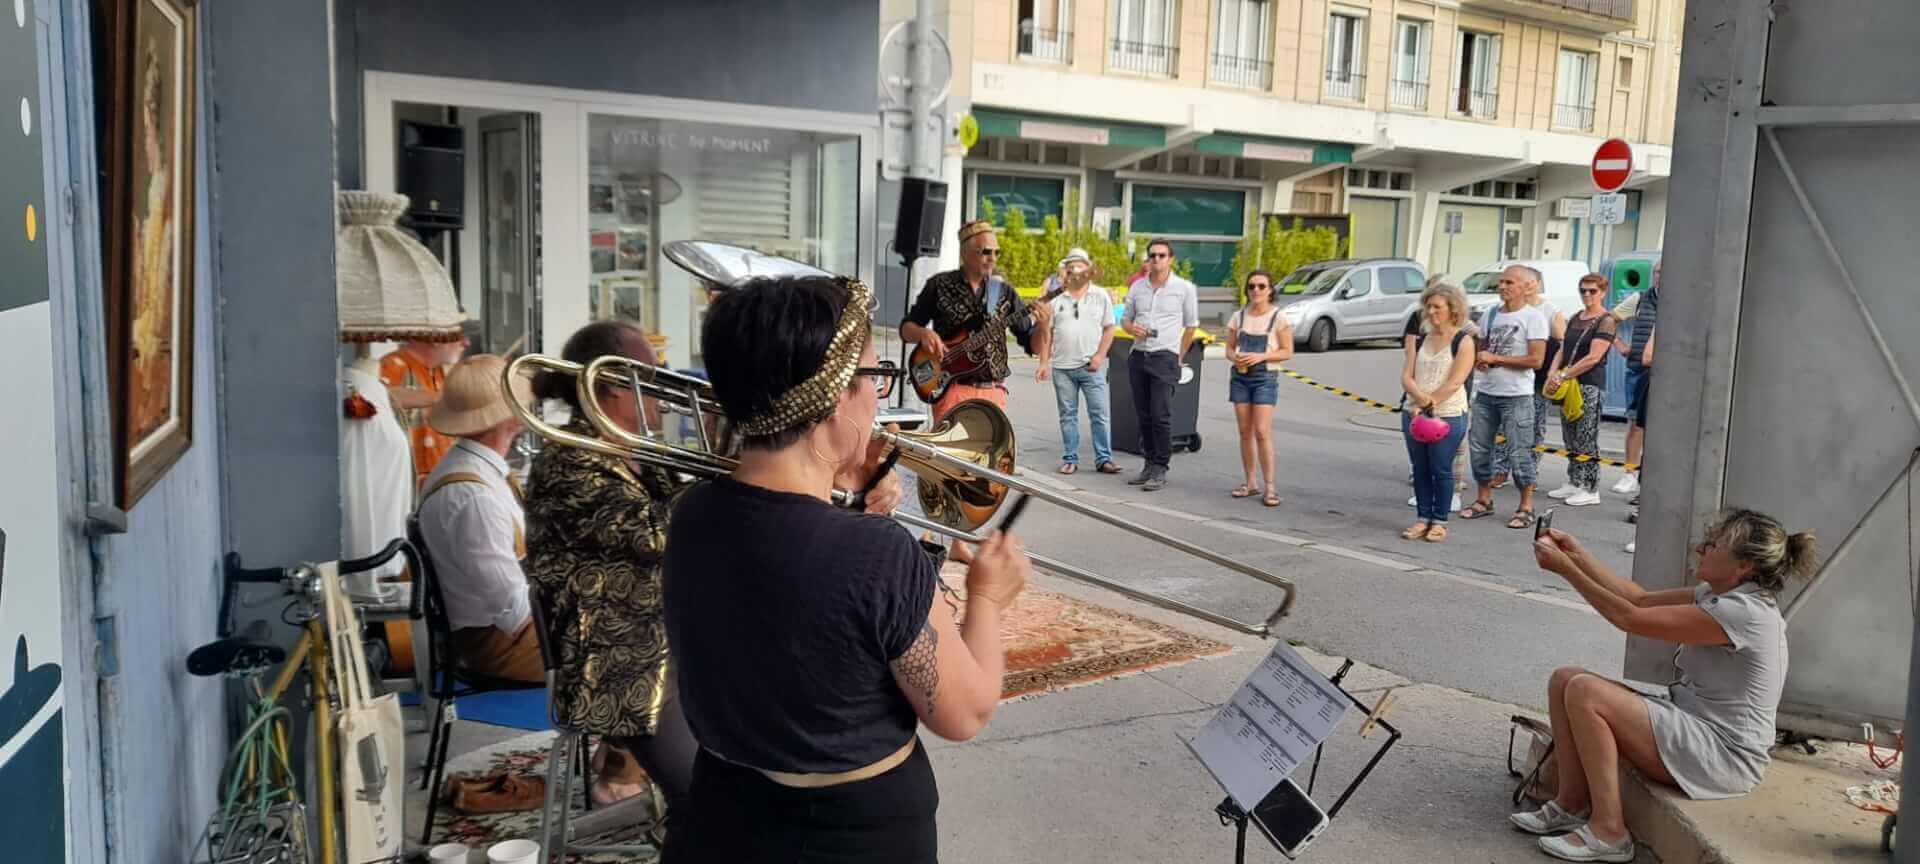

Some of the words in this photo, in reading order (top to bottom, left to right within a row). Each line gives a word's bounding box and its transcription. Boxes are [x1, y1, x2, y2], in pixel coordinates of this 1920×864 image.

[610, 128, 678, 149] VITRINE
[712, 136, 771, 152] MOMENT
[1600, 196, 1617, 204] SAUF
